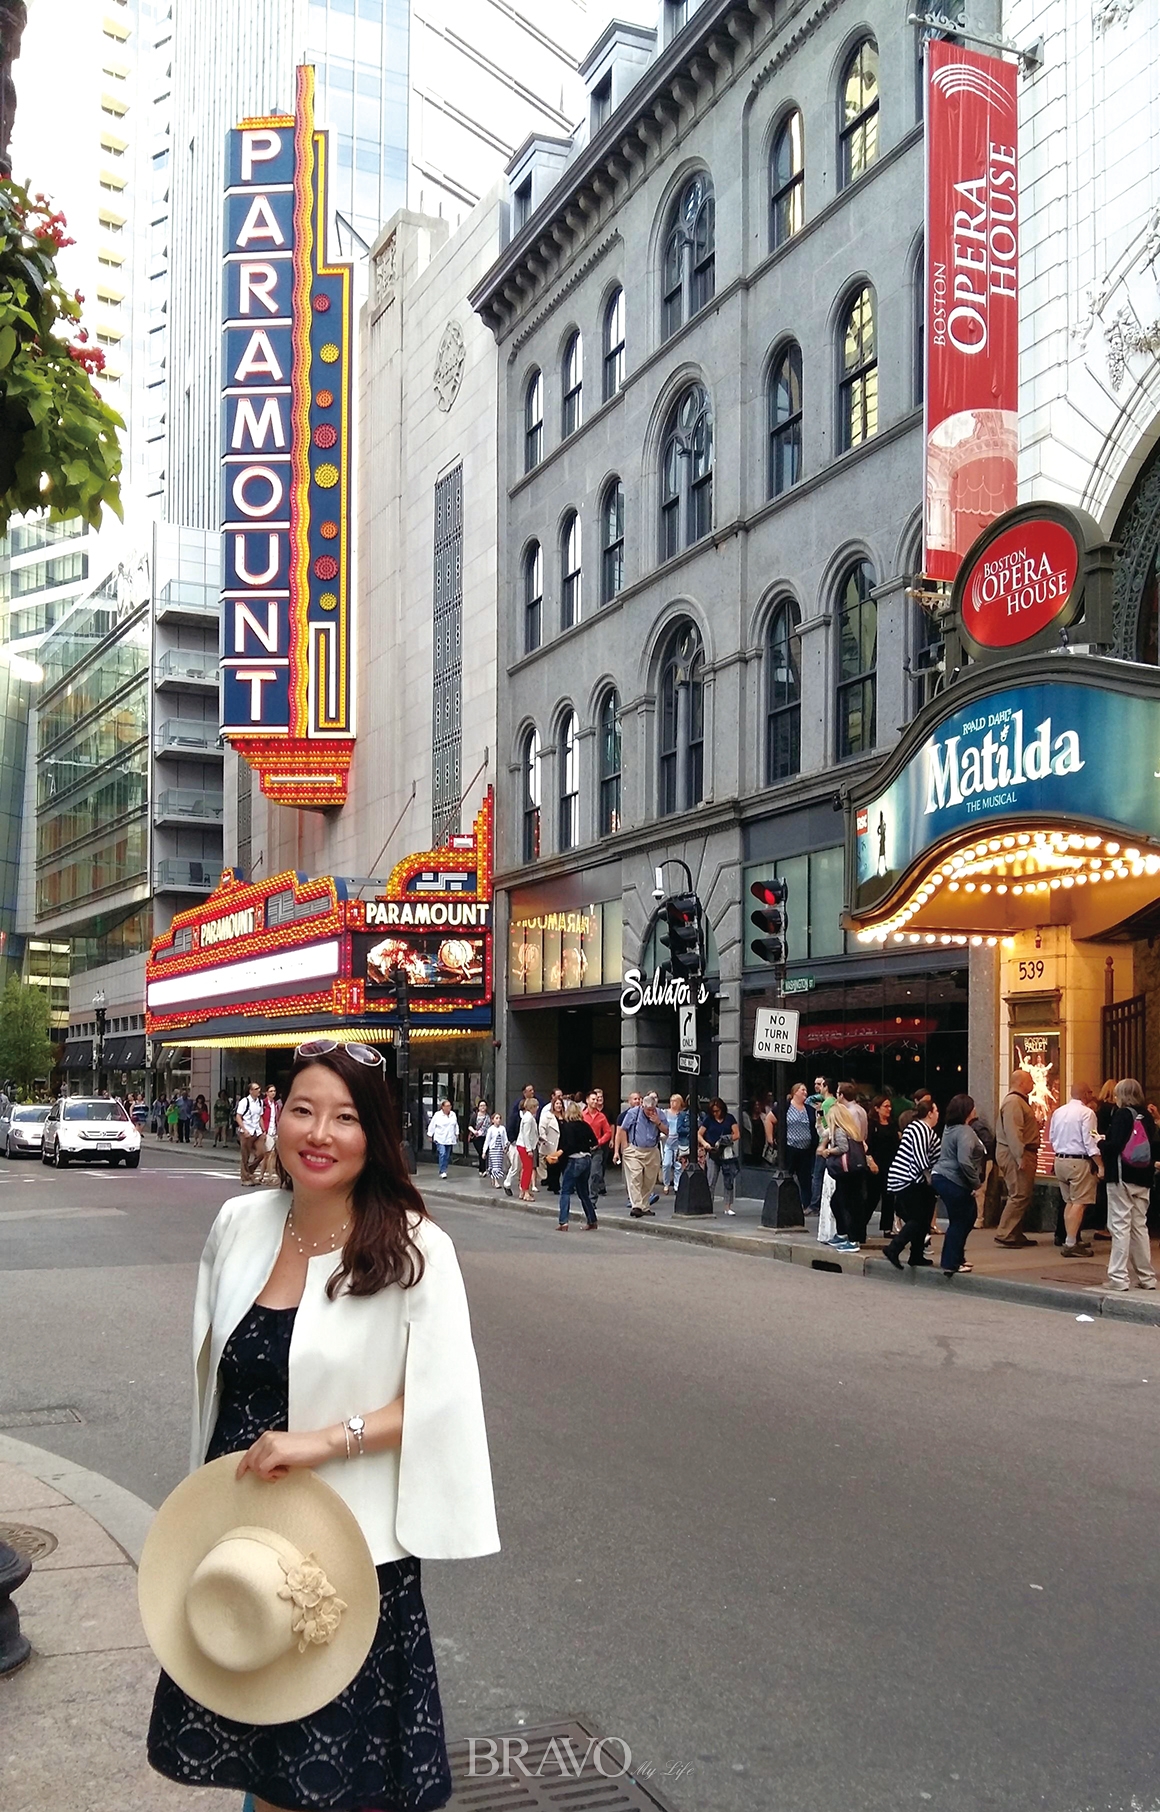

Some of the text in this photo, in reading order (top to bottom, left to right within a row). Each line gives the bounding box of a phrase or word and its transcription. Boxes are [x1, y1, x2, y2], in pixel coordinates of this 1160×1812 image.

[989, 141, 1017, 301] HOUSE
[947, 173, 988, 355] OPERA
[933, 262, 947, 347] BOSTON
[231, 129, 285, 721] PARAMOUNT
[982, 552, 1053, 602] OPERA
[984, 547, 1027, 578] BOSTON
[1007, 572, 1067, 616] HOUSE
[962, 717, 986, 735] ROALD
[924, 709, 1085, 815] Matilda
[966, 791, 1017, 813] THE MUSICAL
[200, 907, 254, 947] PARAMOUNT
[366, 902, 490, 926] PARAMOUNT
[1019, 960, 1044, 980] 539
[764, 1028, 789, 1040] TURN
[769, 1015, 786, 1026] NO
[682, 1038, 694, 1047] ONLY
[757, 1042, 793, 1055] ON RED
